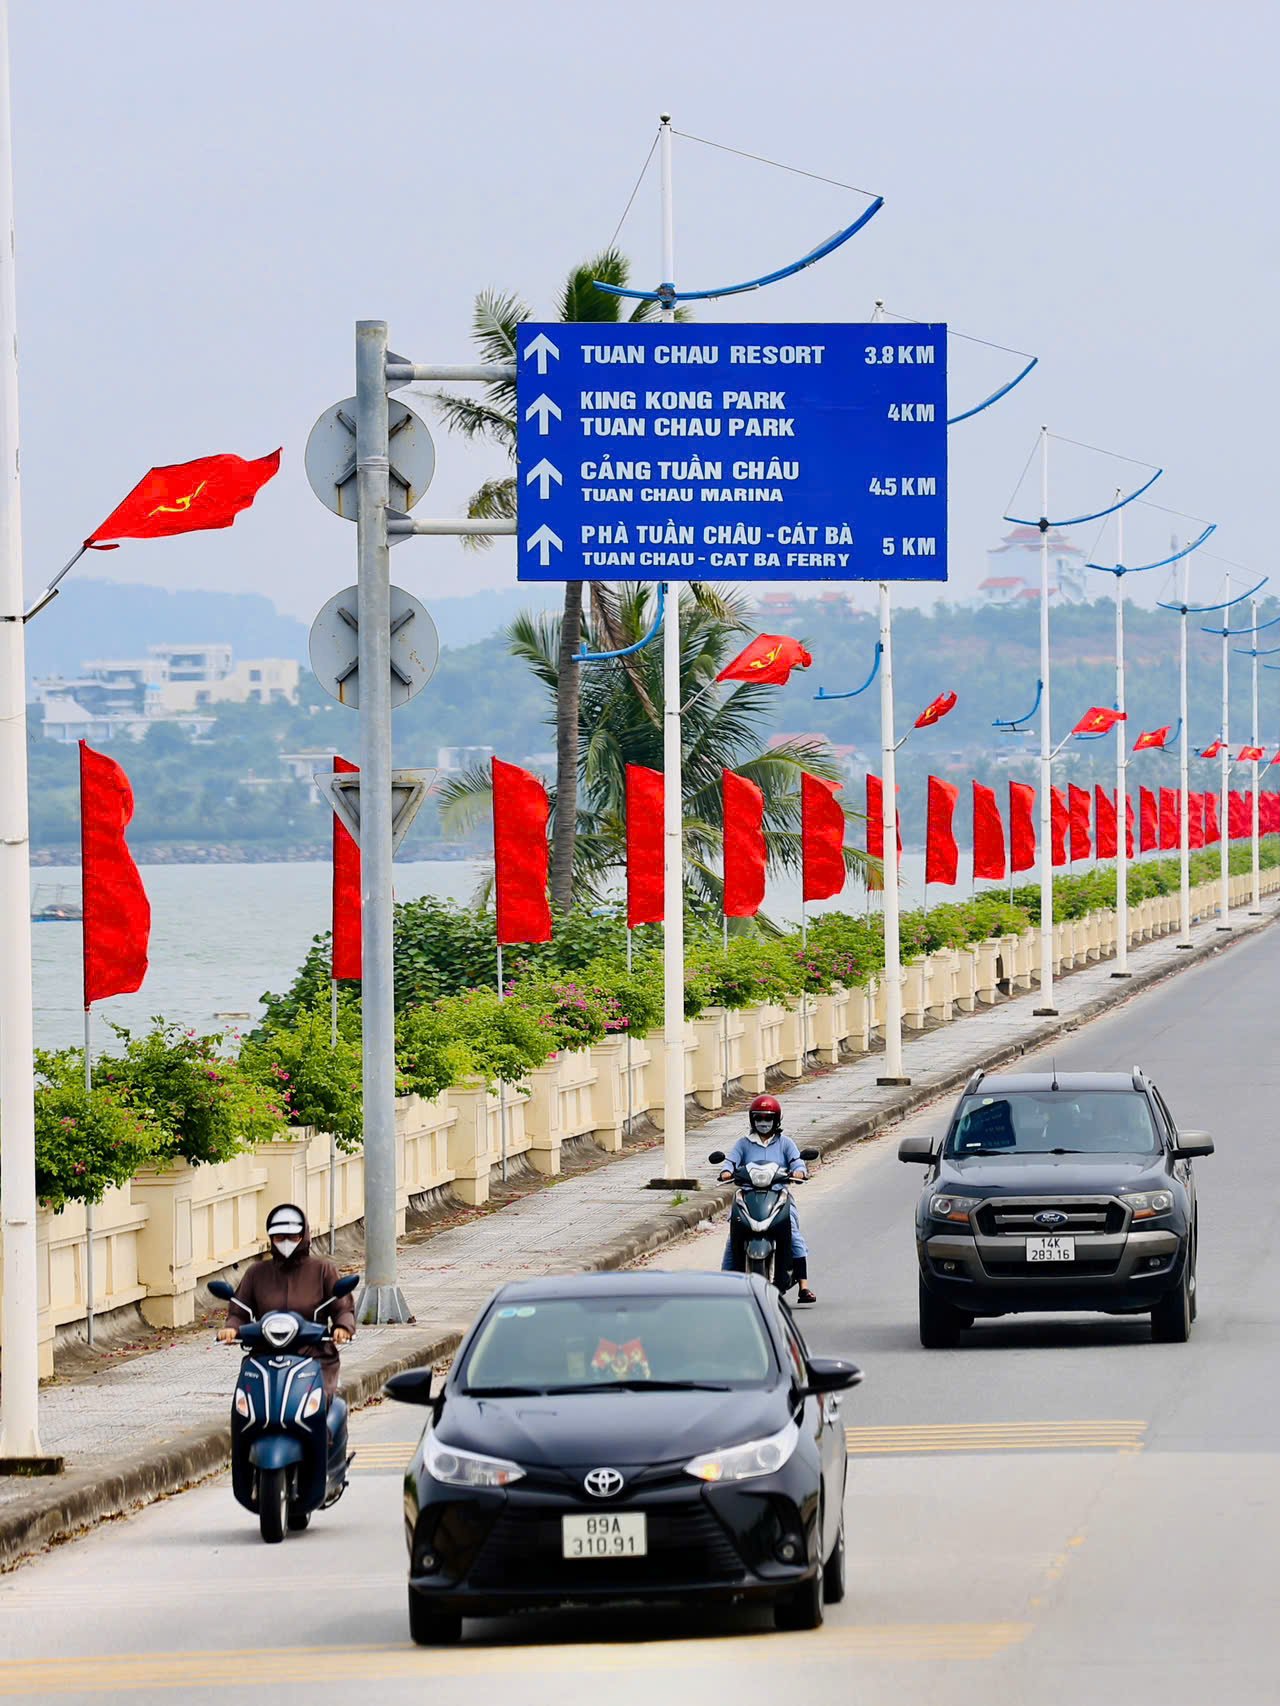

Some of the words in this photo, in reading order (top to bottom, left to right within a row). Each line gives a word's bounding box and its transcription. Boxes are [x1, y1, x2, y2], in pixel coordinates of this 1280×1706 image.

[581, 345, 645, 364] TUAN
[654, 345, 718, 365] CHAU
[730, 345, 826, 365] RESORT
[580, 391, 637, 410] KING
[645, 391, 713, 410] KONG
[722, 391, 786, 410] PARK
[580, 417, 646, 437] TUAN
[654, 417, 721, 437] CHAU
[728, 418, 795, 437] PARK
[580, 453, 652, 480] CẢNG
[658, 453, 722, 480] TUẦN
[732, 456, 800, 480] CHÂU
[581, 488, 634, 502] TUAN
[640, 488, 694, 502] CHAU
[700, 488, 784, 502] MARINA
[581, 520, 629, 544] PHÀ
[635, 518, 695, 545] TUẦN
[825, 522, 854, 545] BÀ
[882, 537, 895, 556] 5
[902, 537, 936, 556] KM
[581, 551, 636, 566] TUAN
[753, 552, 781, 567] BA
[786, 553, 850, 567] FERRY
[1041, 1213, 1060, 1222] Ford
[1041, 1238, 1061, 1249] 14K
[1031, 1249, 1070, 1261] 283.16
[587, 1517, 621, 1535] 89A
[573, 1536, 634, 1555] 310.91
